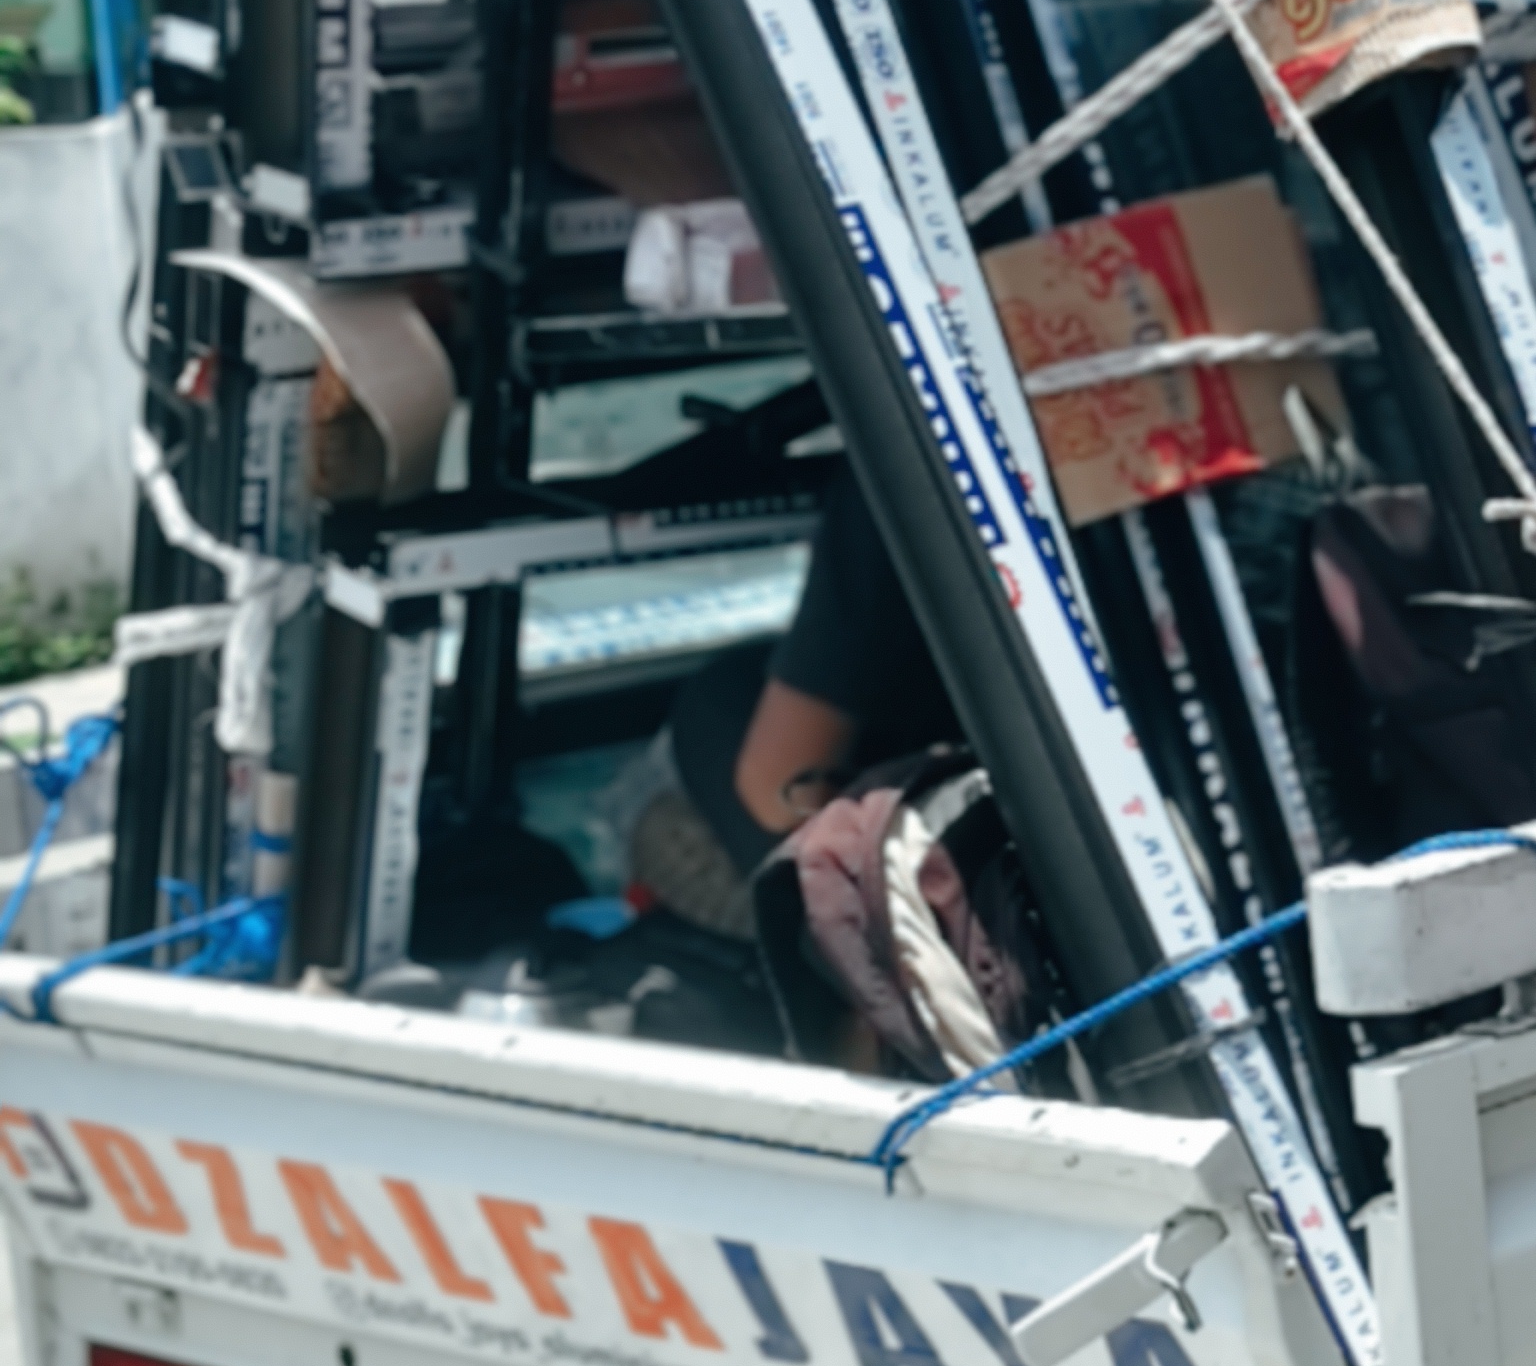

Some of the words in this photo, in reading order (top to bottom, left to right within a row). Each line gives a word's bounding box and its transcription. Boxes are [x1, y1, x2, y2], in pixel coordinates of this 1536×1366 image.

[893, 115, 953, 254] INKALUM
[1137, 833, 1199, 942] KALUM
[1231, 1038, 1305, 1183] INKALUM
[1320, 1247, 1382, 1362] KALUM
[66, 1117, 728, 1353] DZALFA
